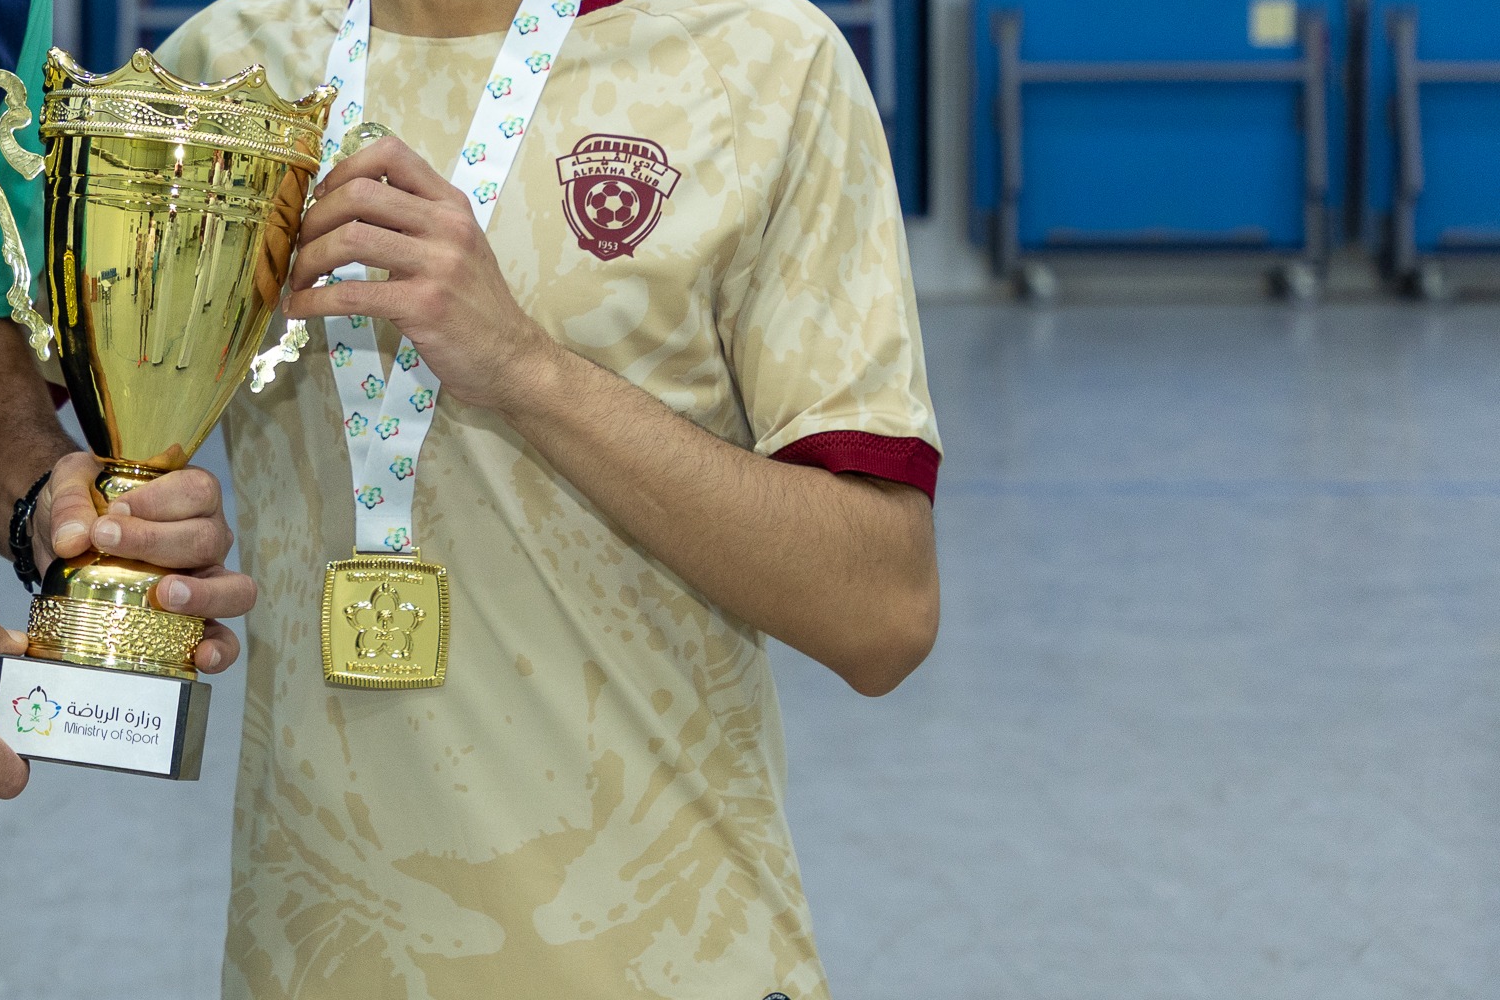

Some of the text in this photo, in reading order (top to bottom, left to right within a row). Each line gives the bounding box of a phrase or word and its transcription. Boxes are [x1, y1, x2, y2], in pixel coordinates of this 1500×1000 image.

[573, 166, 660, 187] ALFAYHA CLUB
[598, 240, 618, 250] 1953
[67, 701, 162, 730] وزارة الرياضة
[64, 721, 159, 745] Ministry of Sport
